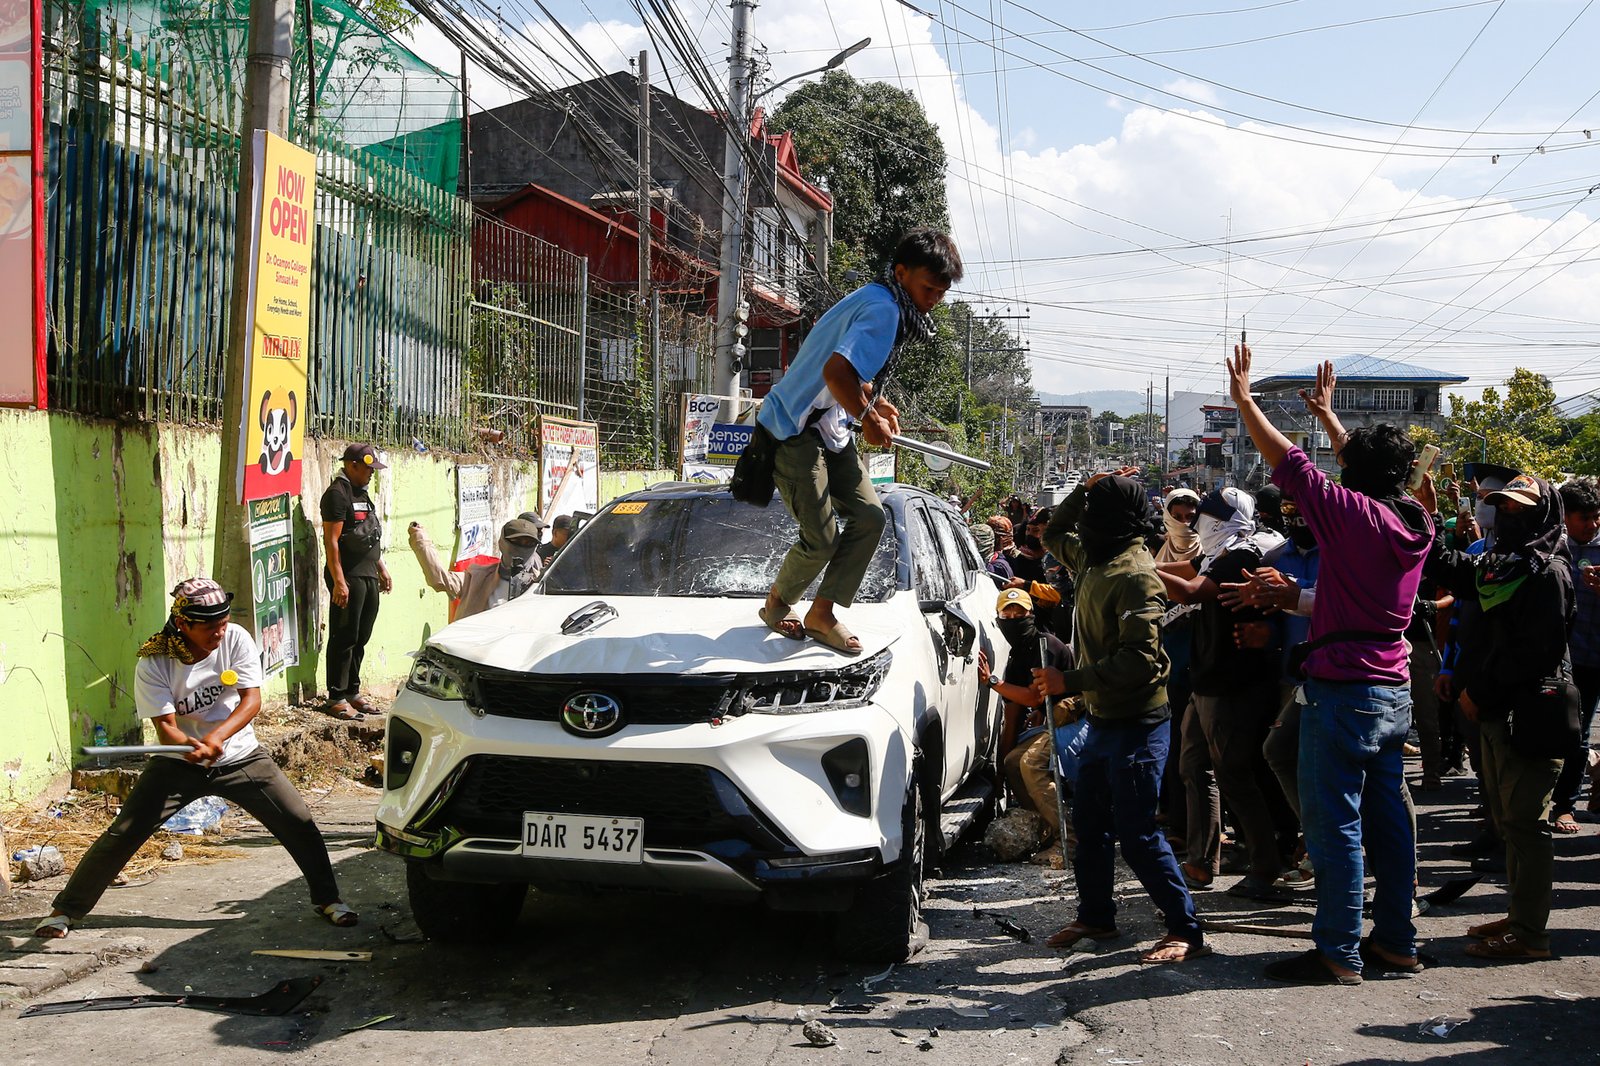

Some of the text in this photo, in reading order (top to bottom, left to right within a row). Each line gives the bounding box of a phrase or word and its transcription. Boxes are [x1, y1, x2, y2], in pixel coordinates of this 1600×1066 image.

[277, 165, 305, 204] NOW
[270, 197, 307, 245] OPEN
[273, 254, 290, 271] Ocampo
[291, 259, 307, 275] Colleges
[275, 271, 299, 287] Sinsuat Ave
[267, 304, 280, 315] Everyday
[280, 306, 289, 315] Needs
[177, 684, 227, 716] CLASS
[526, 822, 639, 852] DAR 5437
